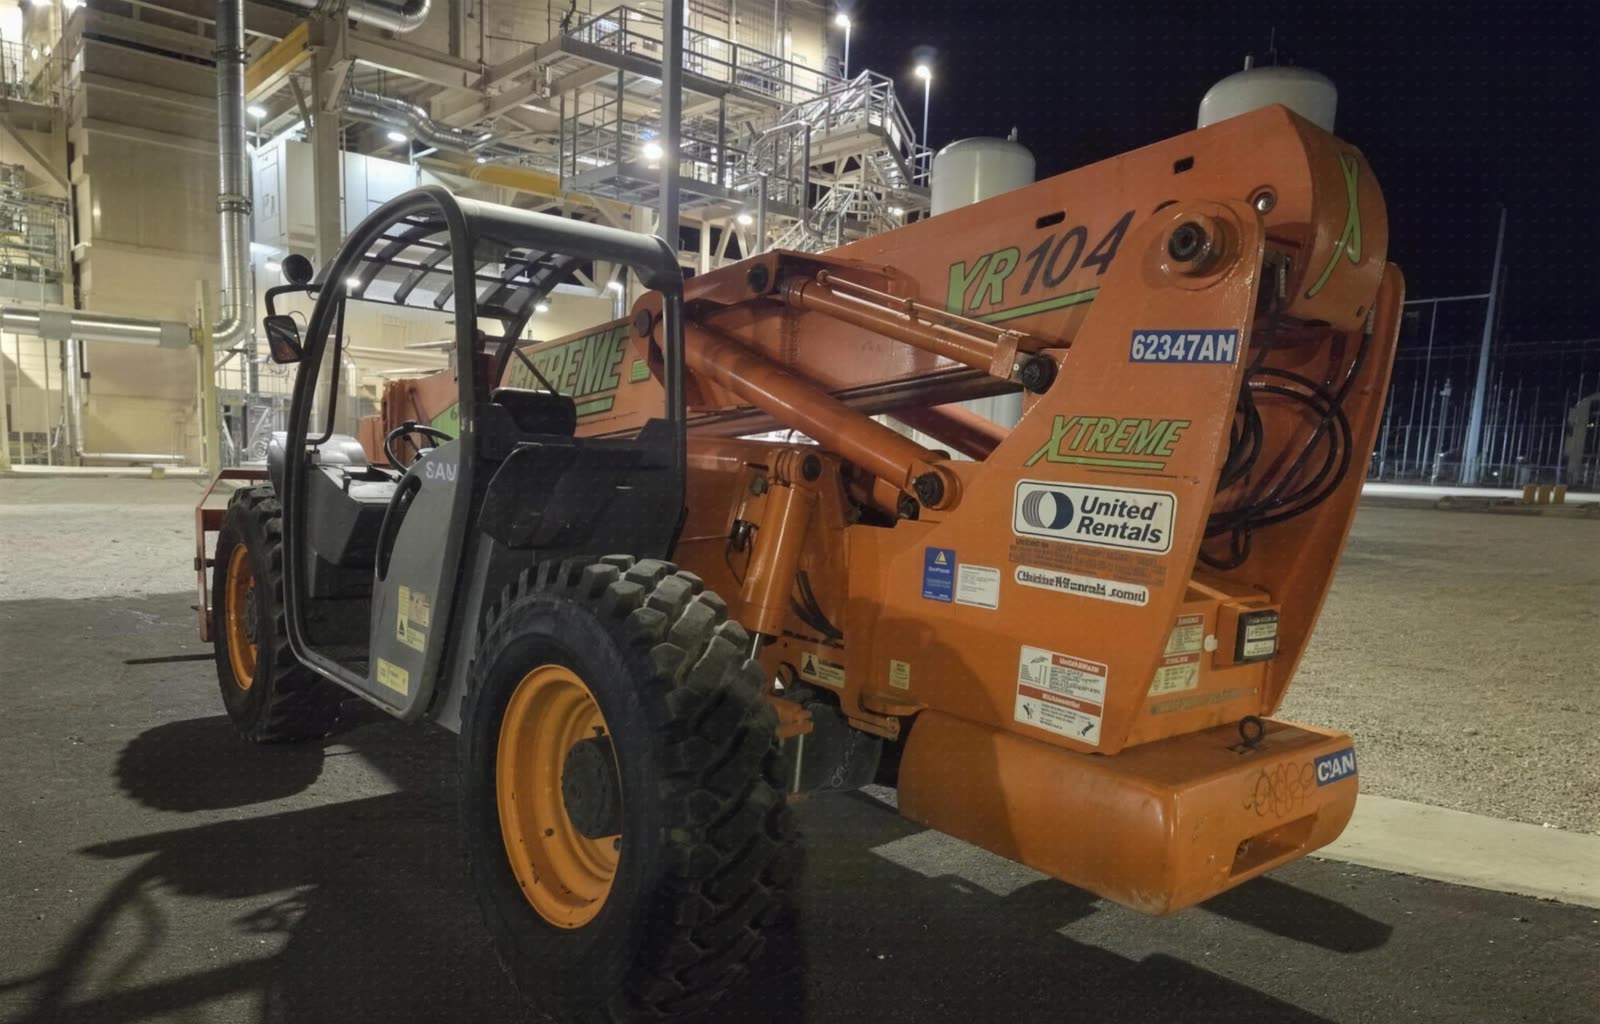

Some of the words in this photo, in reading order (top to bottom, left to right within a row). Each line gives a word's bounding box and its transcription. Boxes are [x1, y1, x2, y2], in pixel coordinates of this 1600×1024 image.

[1020, 210, 1136, 296] 104
[1024, 415, 1192, 467] XTREME
[1080, 495, 1158, 521] United
[1076, 516, 1163, 543] Rentals
